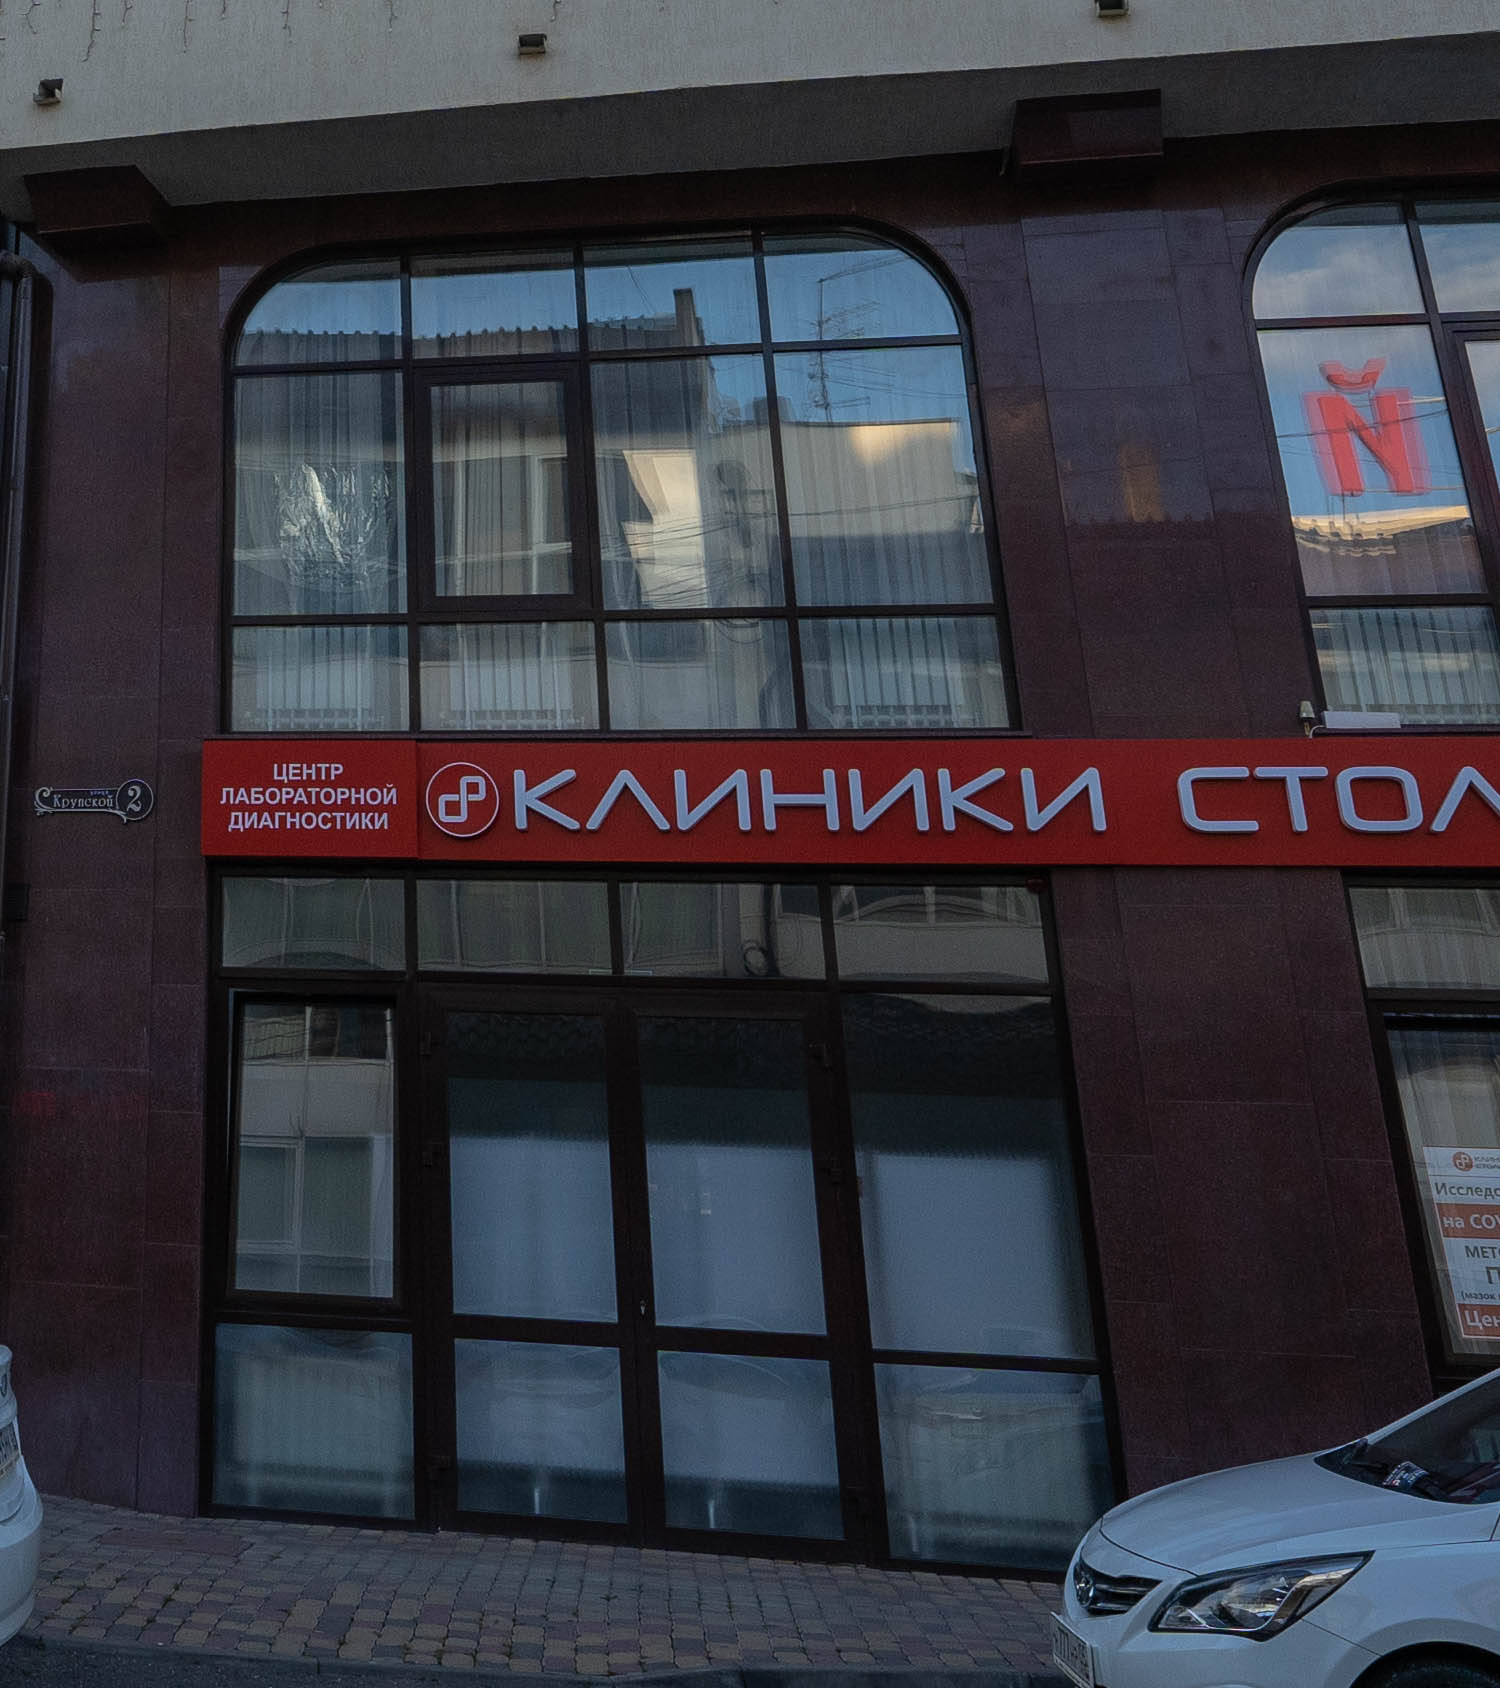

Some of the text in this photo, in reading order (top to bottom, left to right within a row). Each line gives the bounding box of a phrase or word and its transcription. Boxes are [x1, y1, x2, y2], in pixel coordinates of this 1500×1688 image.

[273, 763, 344, 783] ЦЕНТР
[53, 785, 142, 812] Крупской 2
[219, 783, 398, 805] ЛАБОРАТОРНОЙ
[513, 767, 1108, 833] КЛИНИКИ
[228, 811, 389, 832] ДИАГНОСТИКИ
[1443, 1217, 1465, 1228] на
[1460, 1291, 1494, 1301] (мазок
